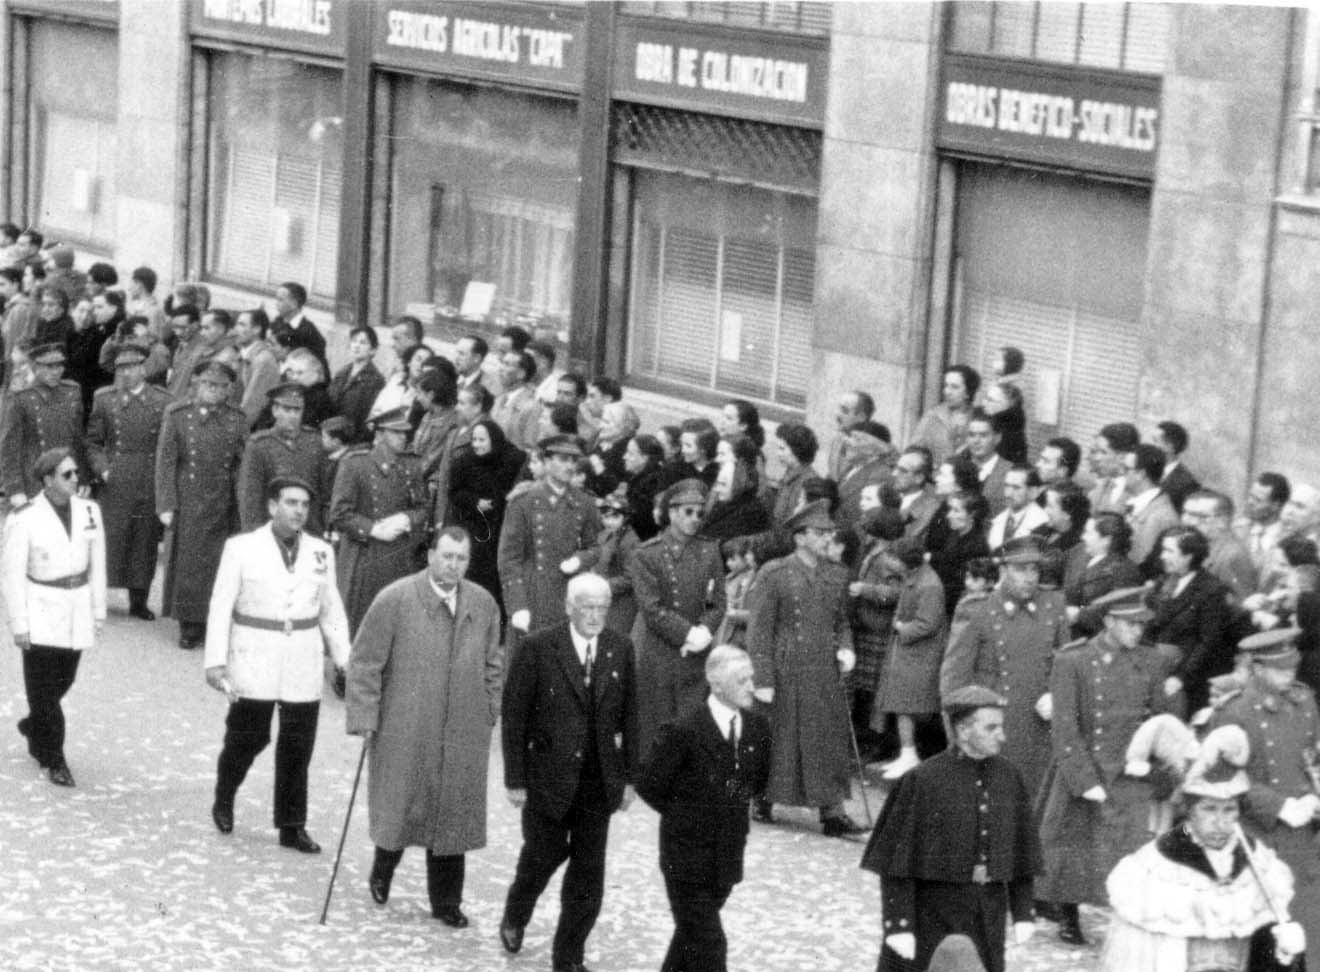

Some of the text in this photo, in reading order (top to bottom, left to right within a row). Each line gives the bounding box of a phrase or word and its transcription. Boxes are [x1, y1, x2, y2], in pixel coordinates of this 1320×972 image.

[386, 10, 448, 53] SERVICIOS
[452, 17, 521, 63] AGRICOLAS
[635, 42, 808, 103] OBRA DE COLONIZACION
[947, 81, 998, 128] OBRAS
